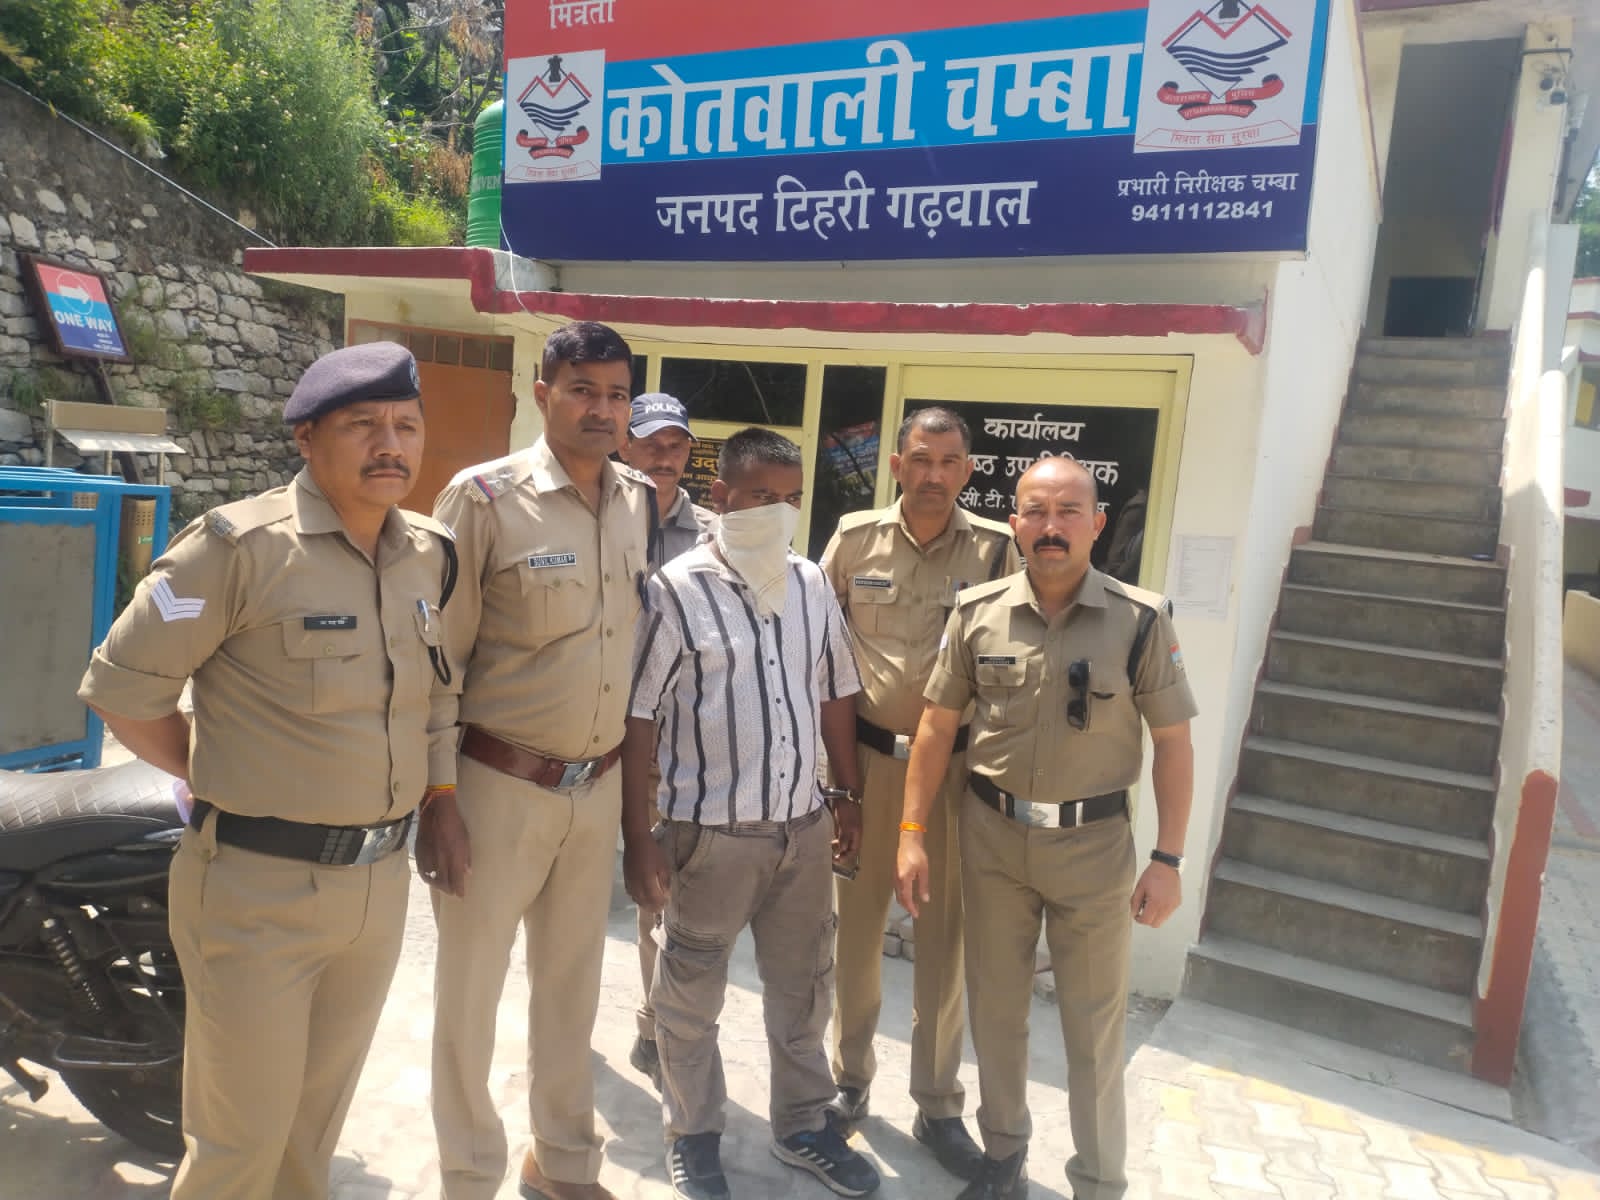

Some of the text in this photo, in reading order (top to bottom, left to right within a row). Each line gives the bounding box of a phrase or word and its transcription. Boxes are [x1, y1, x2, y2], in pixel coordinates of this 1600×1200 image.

[607, 39, 1143, 157] कोतवाली चम्बा
[1118, 169, 1299, 197] प्रभारी निरीक्षक चम्बा
[656, 169, 1038, 240] जनपद टिहरी गढ़वाल
[1131, 200, 1273, 222] 9411112841
[54, 310, 113, 333] ONE WAY
[983, 412, 1086, 443] कार्यालय
